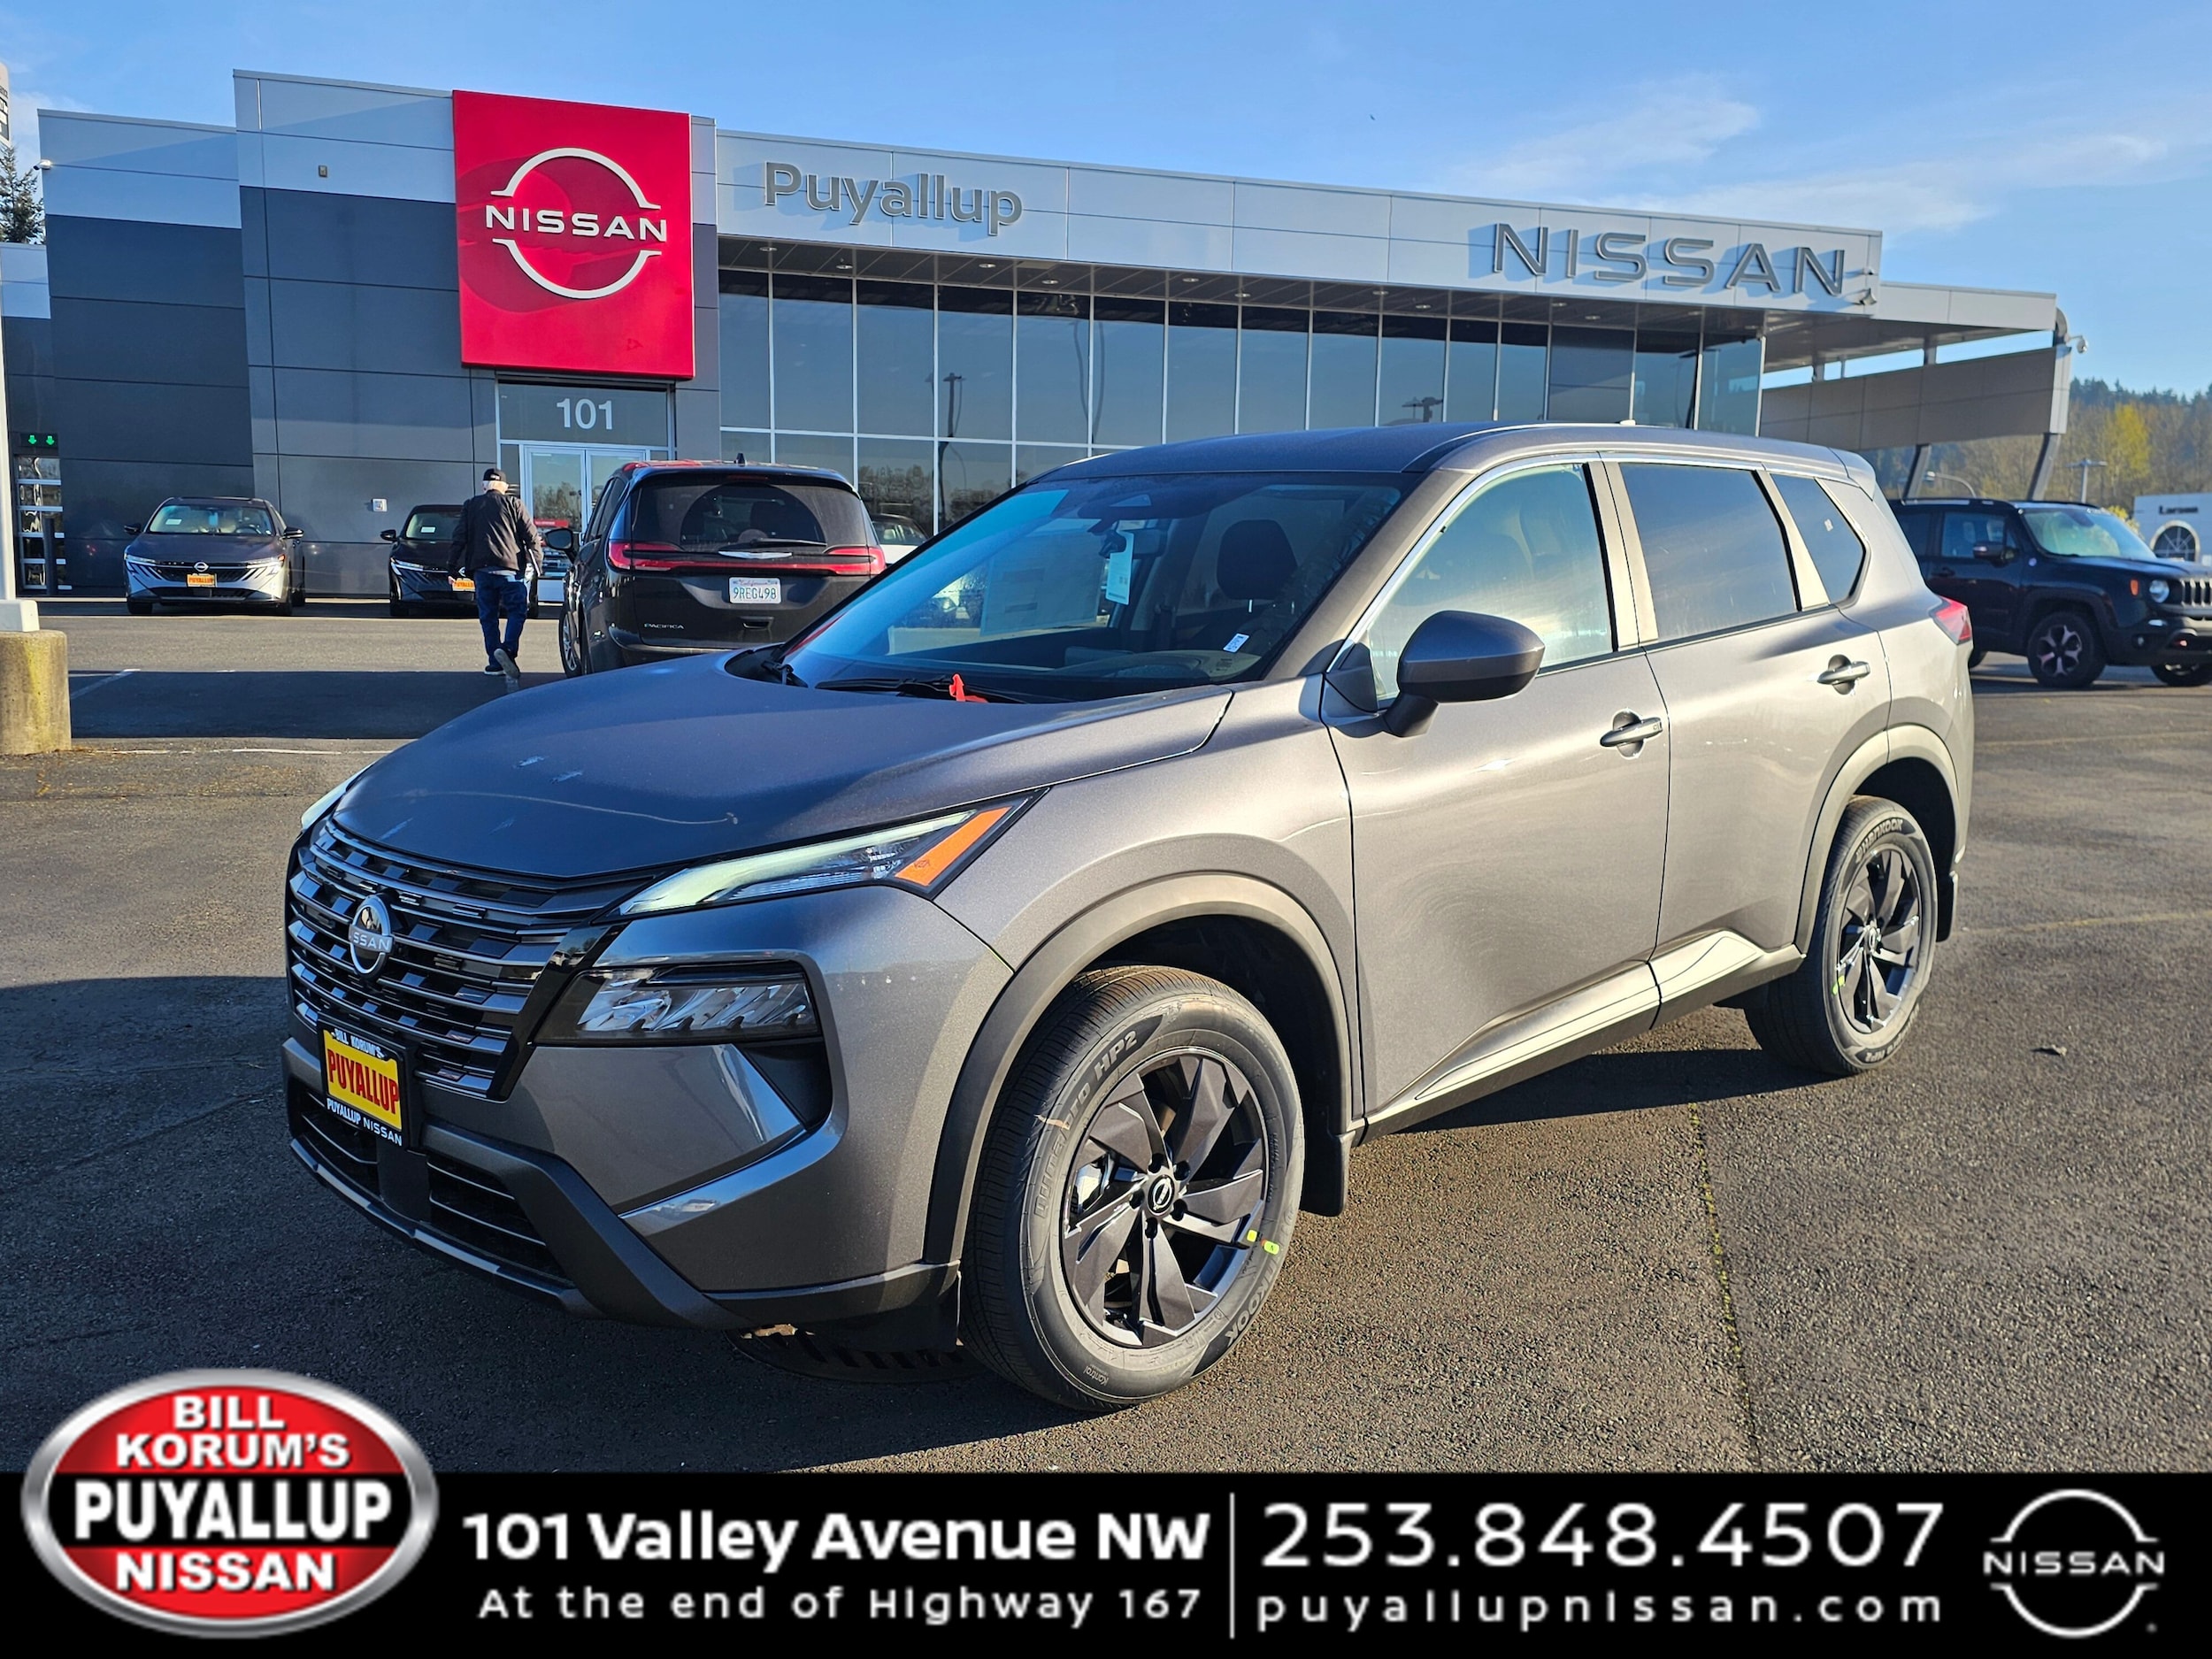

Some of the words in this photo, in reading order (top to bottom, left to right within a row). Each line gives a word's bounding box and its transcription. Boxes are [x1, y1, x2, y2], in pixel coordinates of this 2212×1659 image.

[764, 161, 1023, 236] Puyallup
[486, 204, 667, 242] NISSAN
[1494, 223, 1845, 296] NISSAN
[556, 398, 612, 430] 101
[733, 588, 777, 600] 9REG498
[334, 1028, 349, 1045] BILL
[349, 1035, 381, 1057] KORUM'S
[1094, 1030, 1138, 1081] HP2
[327, 1048, 399, 1115] PUYALLUP
[326, 1097, 362, 1125] PUYALLUP
[363, 1117, 403, 1147] NISSAN
[1083, 1365, 1110, 1386] Kontrol
